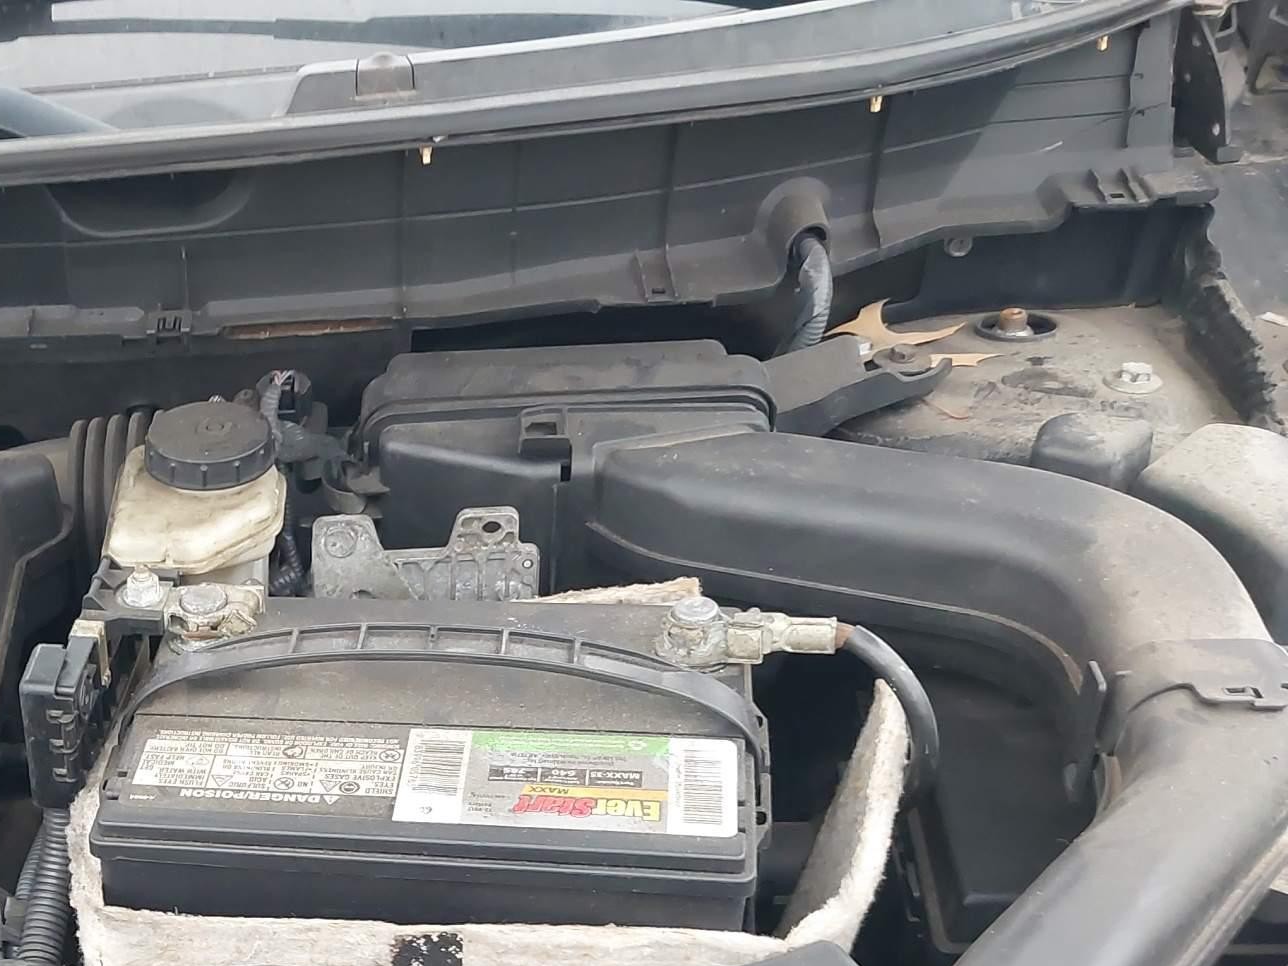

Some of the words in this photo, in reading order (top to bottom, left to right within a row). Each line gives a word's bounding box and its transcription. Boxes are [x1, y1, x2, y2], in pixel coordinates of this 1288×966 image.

[590, 771, 640, 779] MAXX-35
[528, 786, 569, 794] MAXX
[180, 789, 320, 803] DANGER/POISON
[512, 794, 661, 822] EverStart
